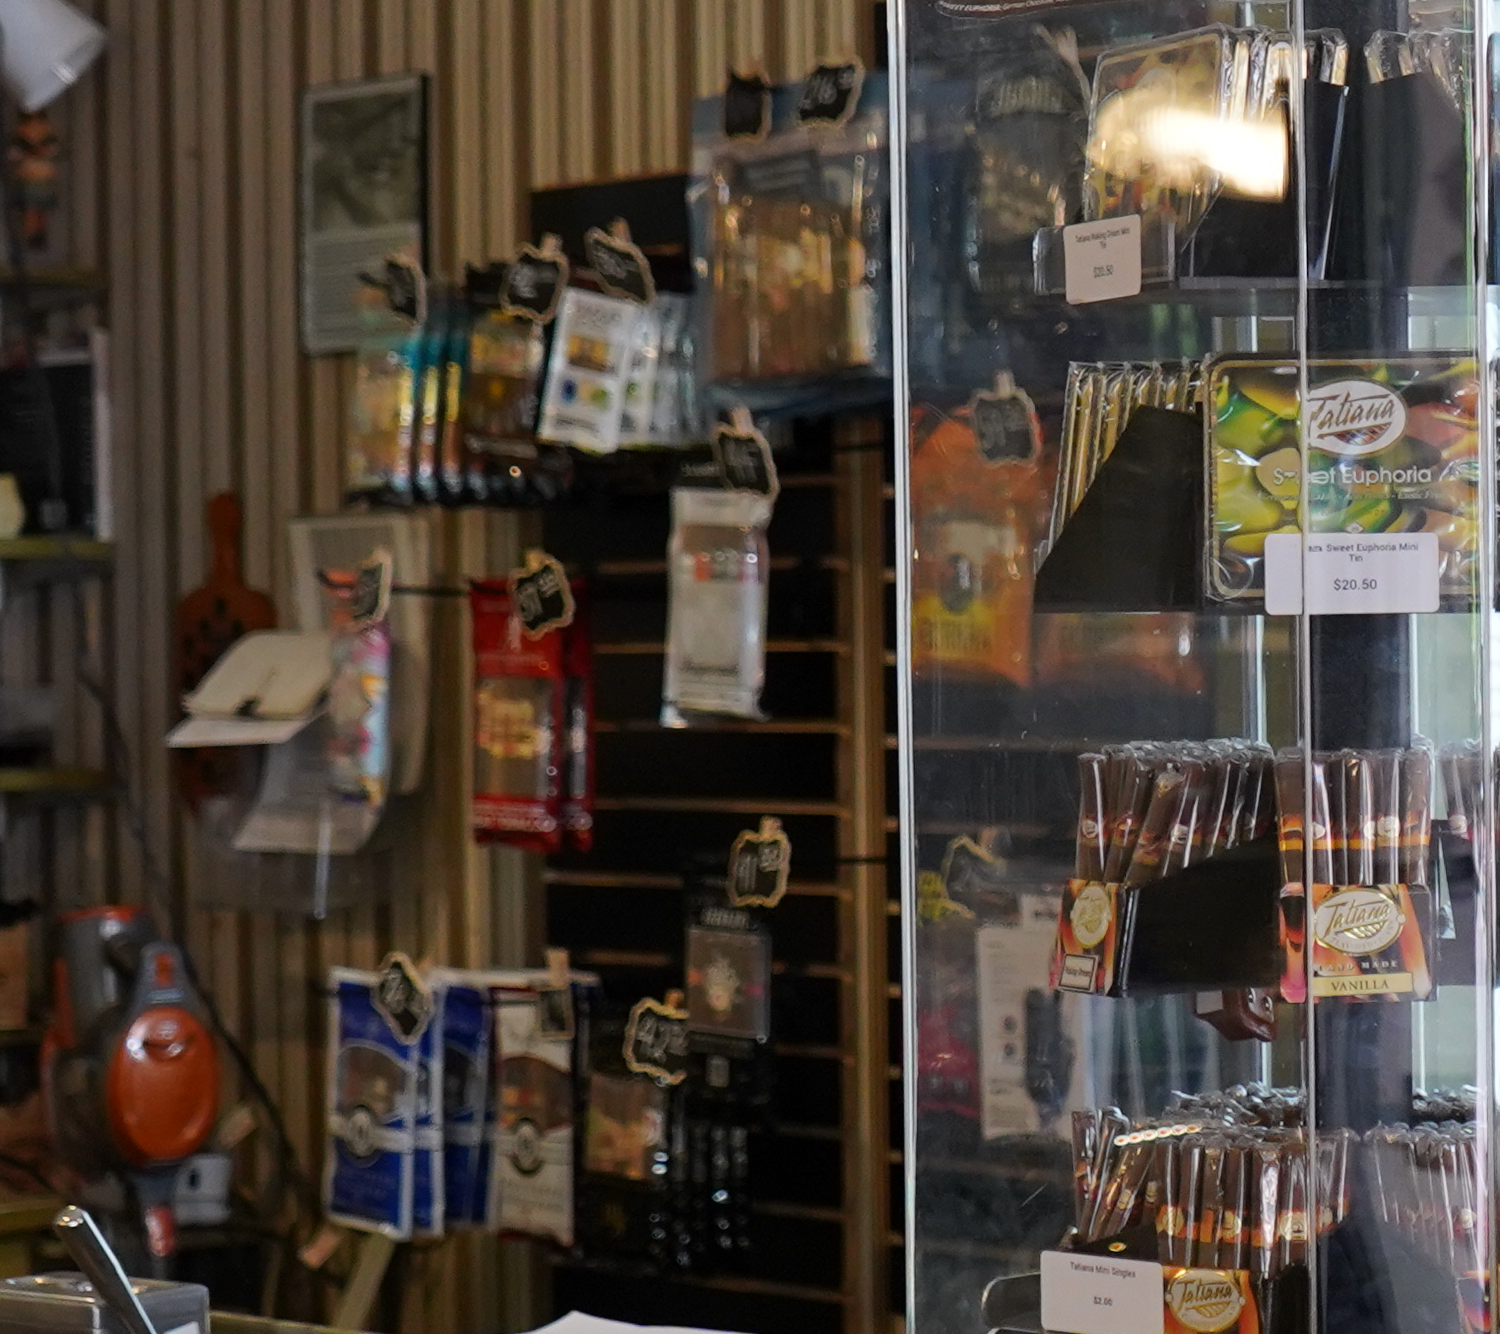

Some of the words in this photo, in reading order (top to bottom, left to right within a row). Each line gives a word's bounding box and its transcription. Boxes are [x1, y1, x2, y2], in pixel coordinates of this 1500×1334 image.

[1341, 465, 1433, 486] Euphoria
[1326, 543, 1355, 552] Sweet
[1356, 542, 1397, 554] Euphoria
[1398, 542, 1419, 552] Mini
[1349, 553, 1363, 563] Tin
[1333, 578, 1378, 591] $20.50
[1322, 898, 1390, 940] Tatiana
[1361, 959, 1399, 970] MADE
[1330, 978, 1390, 992] VANILLA
[1176, 1277, 1234, 1313] Tatiana
